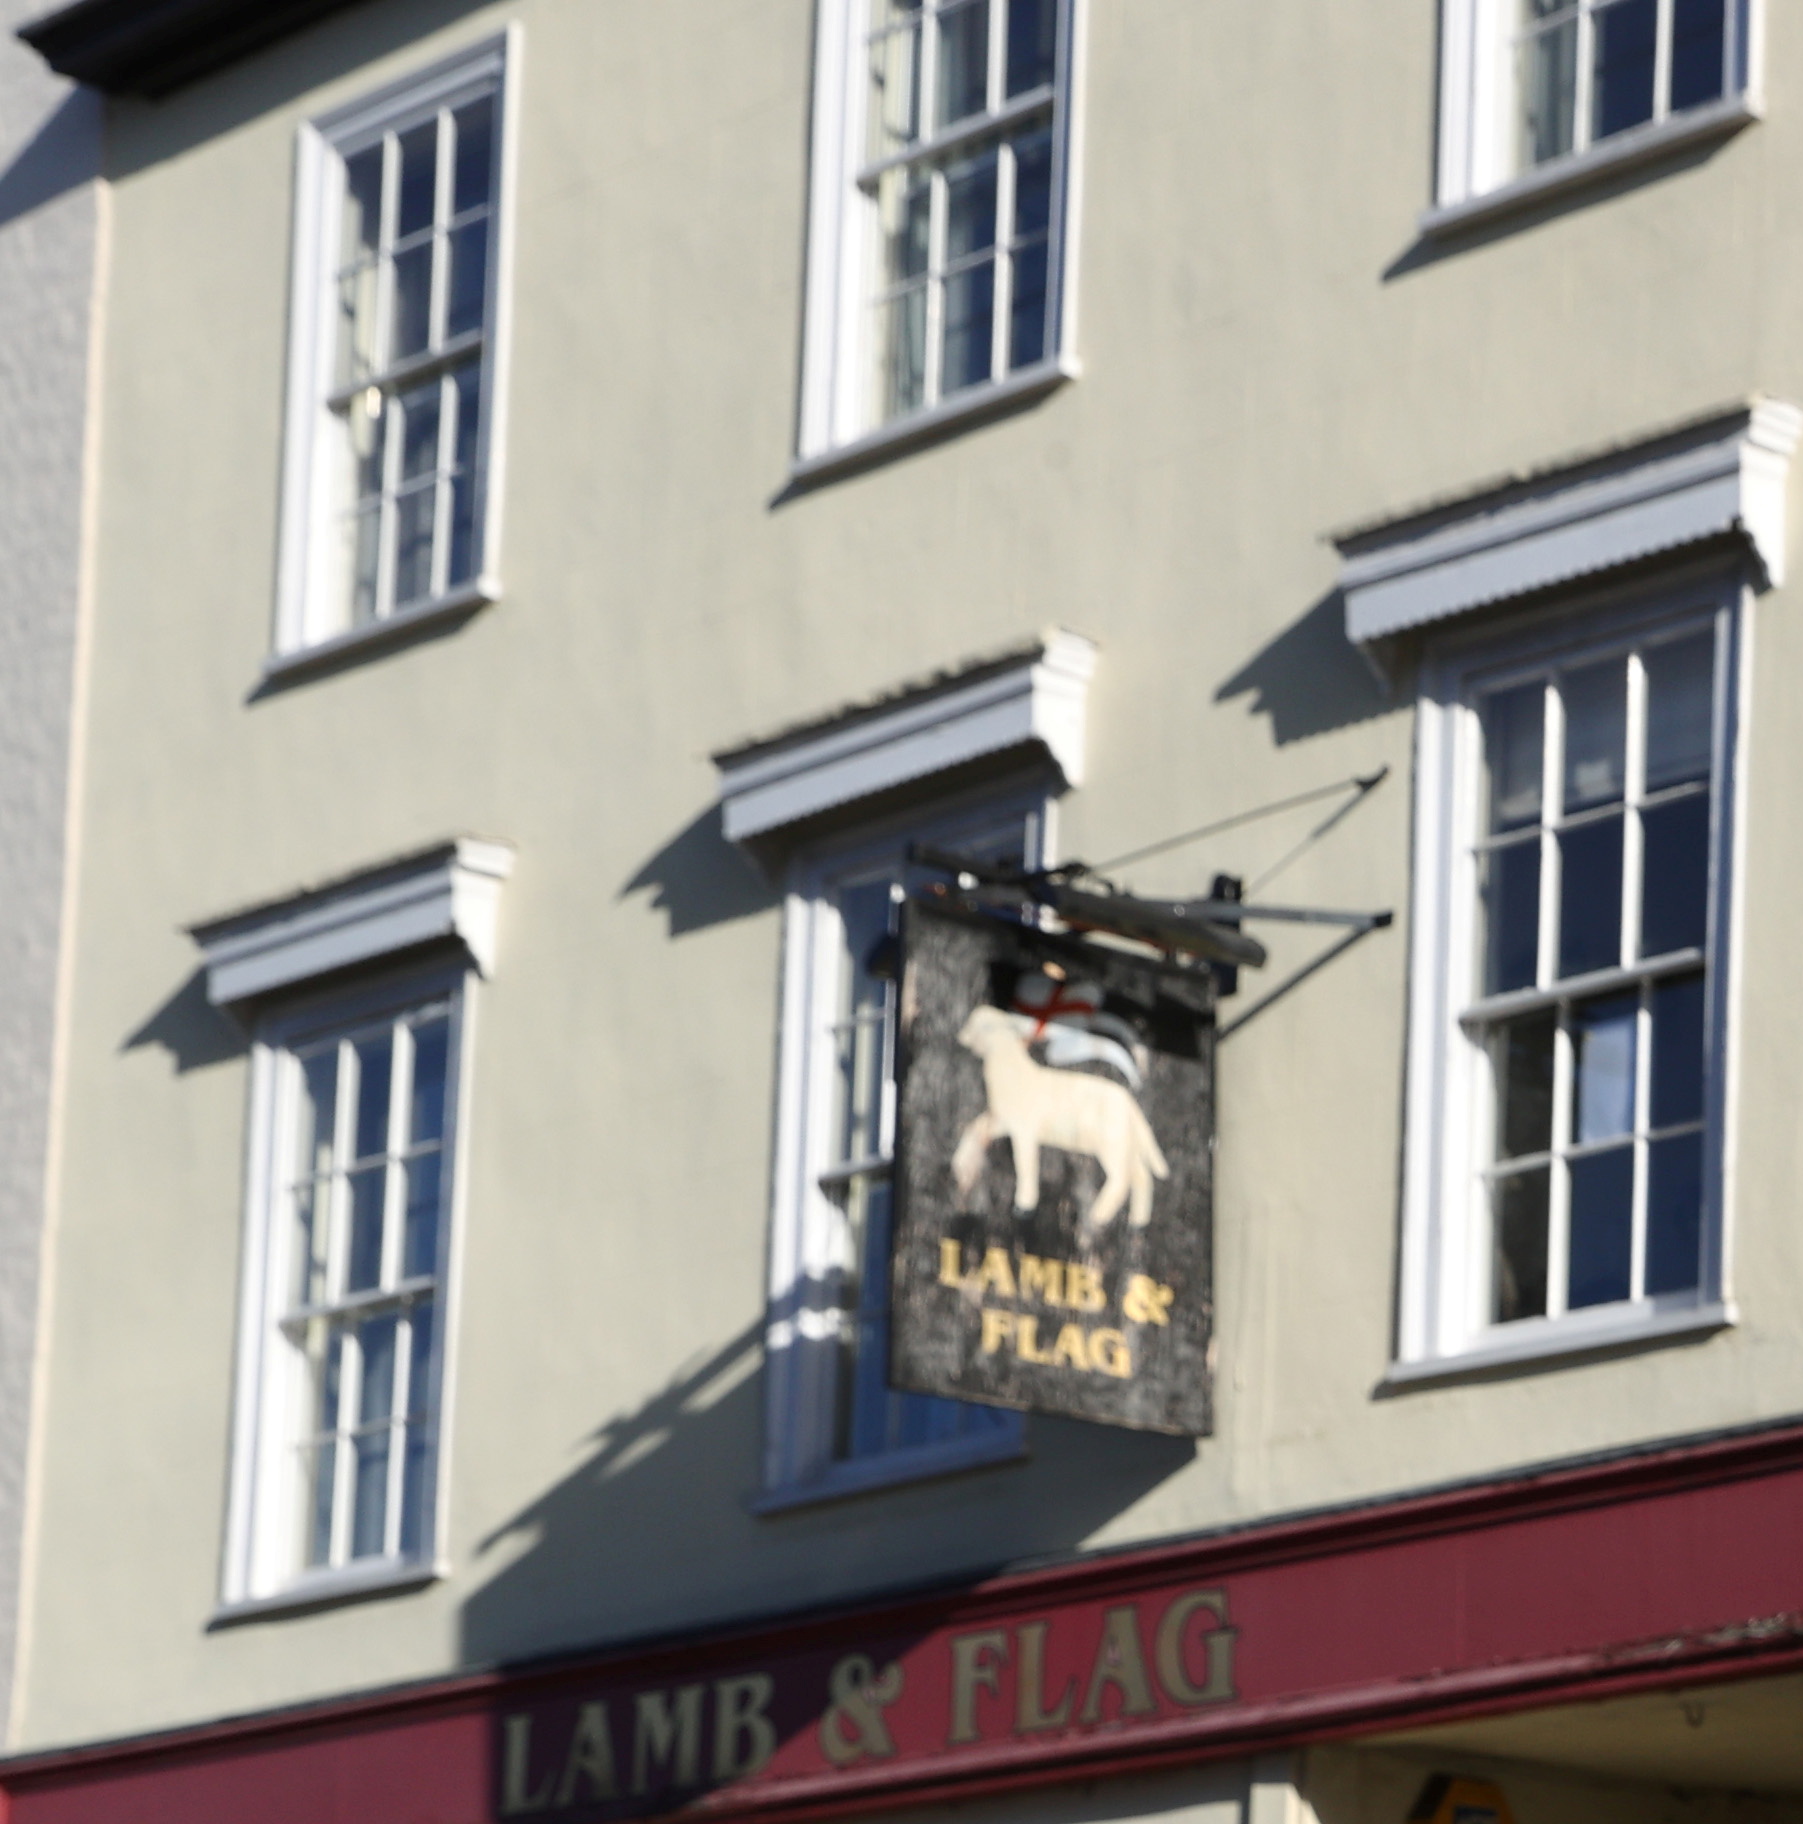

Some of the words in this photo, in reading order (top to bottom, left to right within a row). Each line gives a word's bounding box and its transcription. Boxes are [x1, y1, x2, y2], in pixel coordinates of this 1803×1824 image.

[938, 1237, 1109, 1311] LAMB
[1120, 1273, 1175, 1326] &
[980, 1307, 1133, 1379] FLAG
[499, 1671, 778, 1818] LAMB
[816, 1652, 907, 1767] &
[946, 1586, 1240, 1746] FLAG
